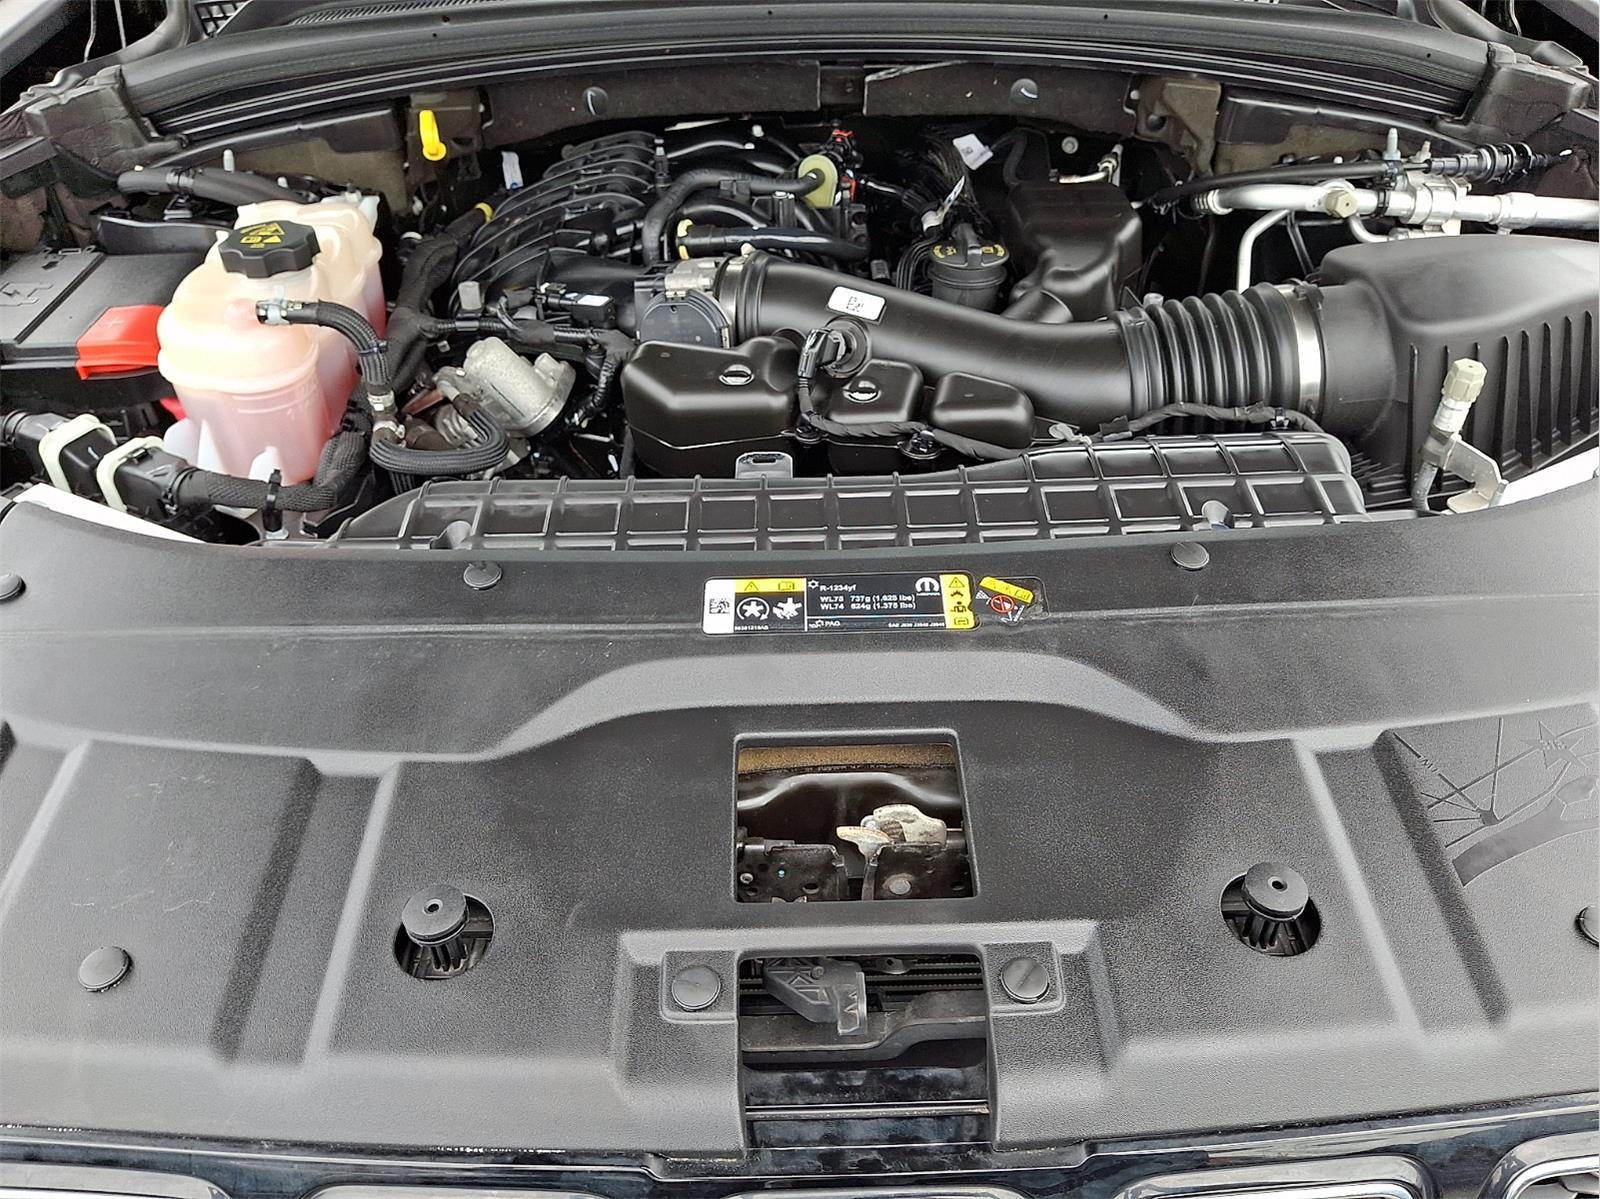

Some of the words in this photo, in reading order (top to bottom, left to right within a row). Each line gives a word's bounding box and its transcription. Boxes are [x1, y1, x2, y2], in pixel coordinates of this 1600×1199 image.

[820, 584, 857, 592] R-1234yf
[850, 595, 871, 603] 737g
[899, 594, 915, 602] lbs)
[899, 602, 916, 610] lbs)
